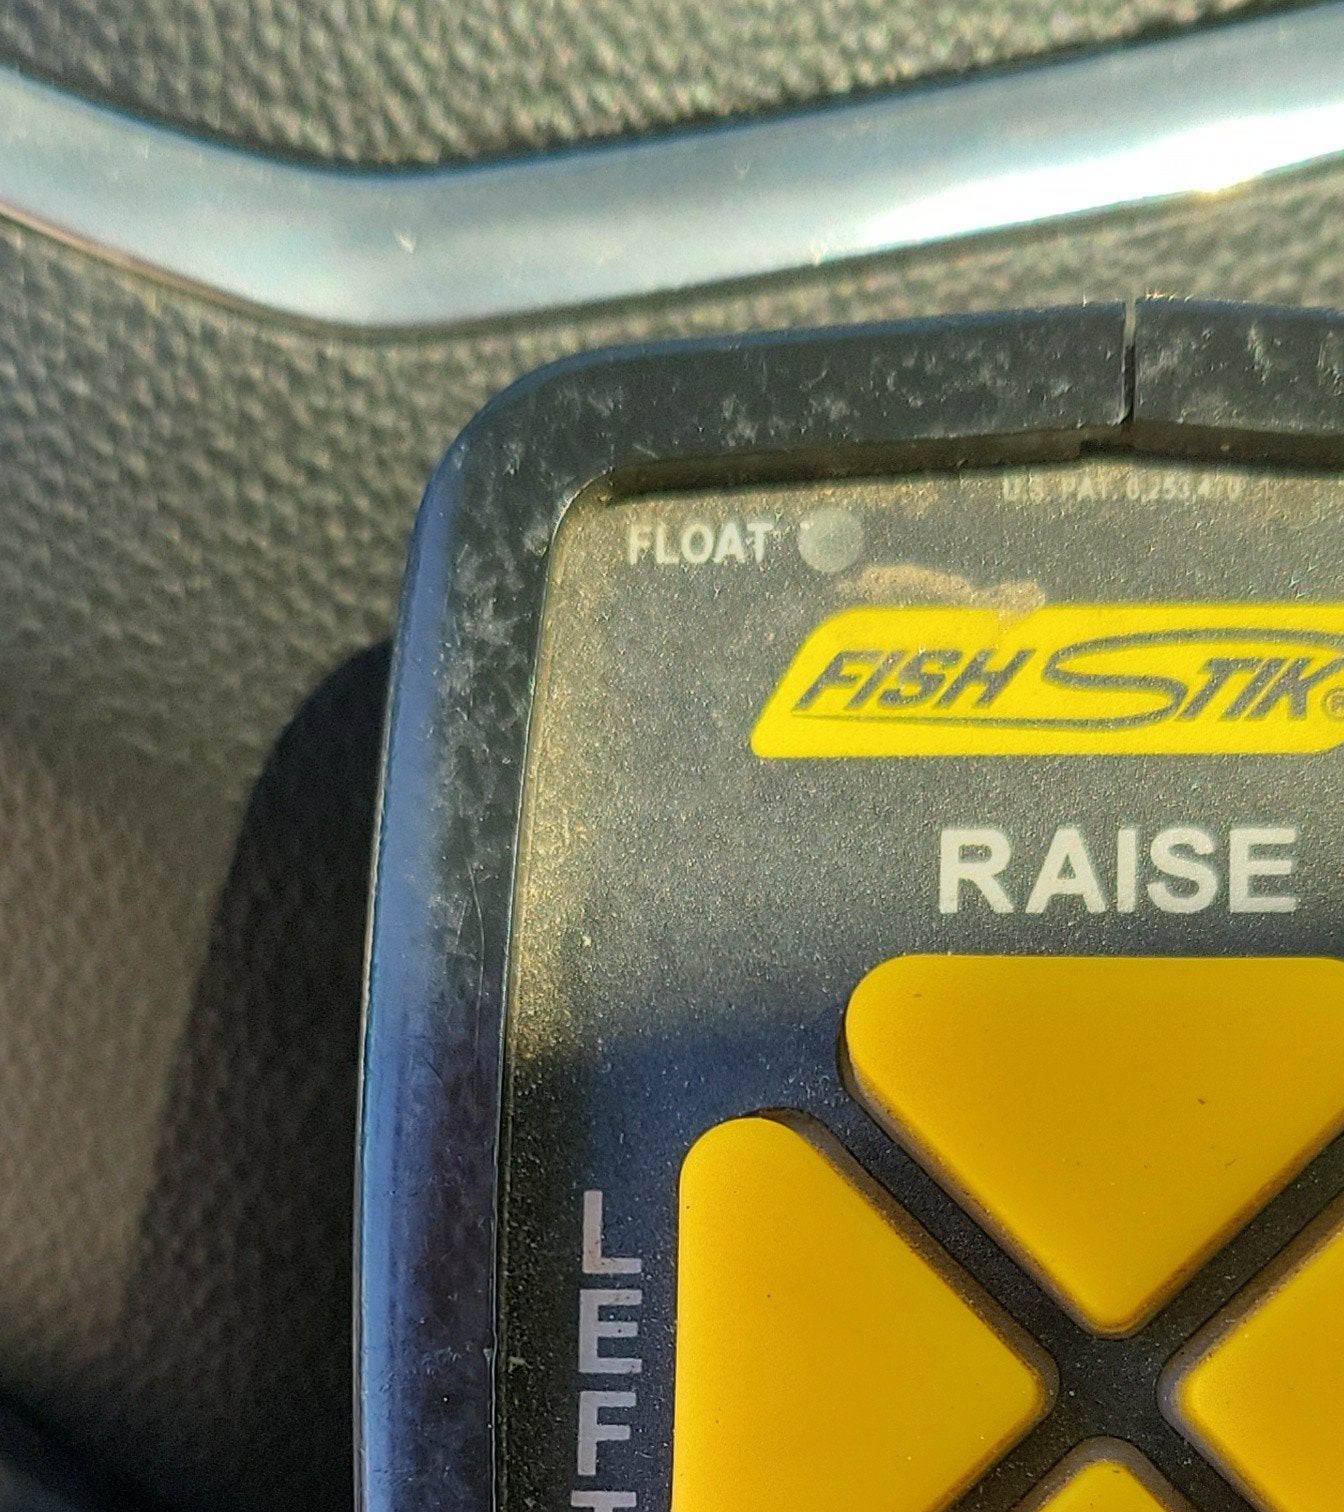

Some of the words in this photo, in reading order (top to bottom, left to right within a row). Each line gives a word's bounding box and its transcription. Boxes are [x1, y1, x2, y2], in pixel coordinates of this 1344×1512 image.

[627, 521, 774, 565] FLOAT
[792, 647, 1037, 712] FISH
[936, 826, 1300, 915] RAISE
